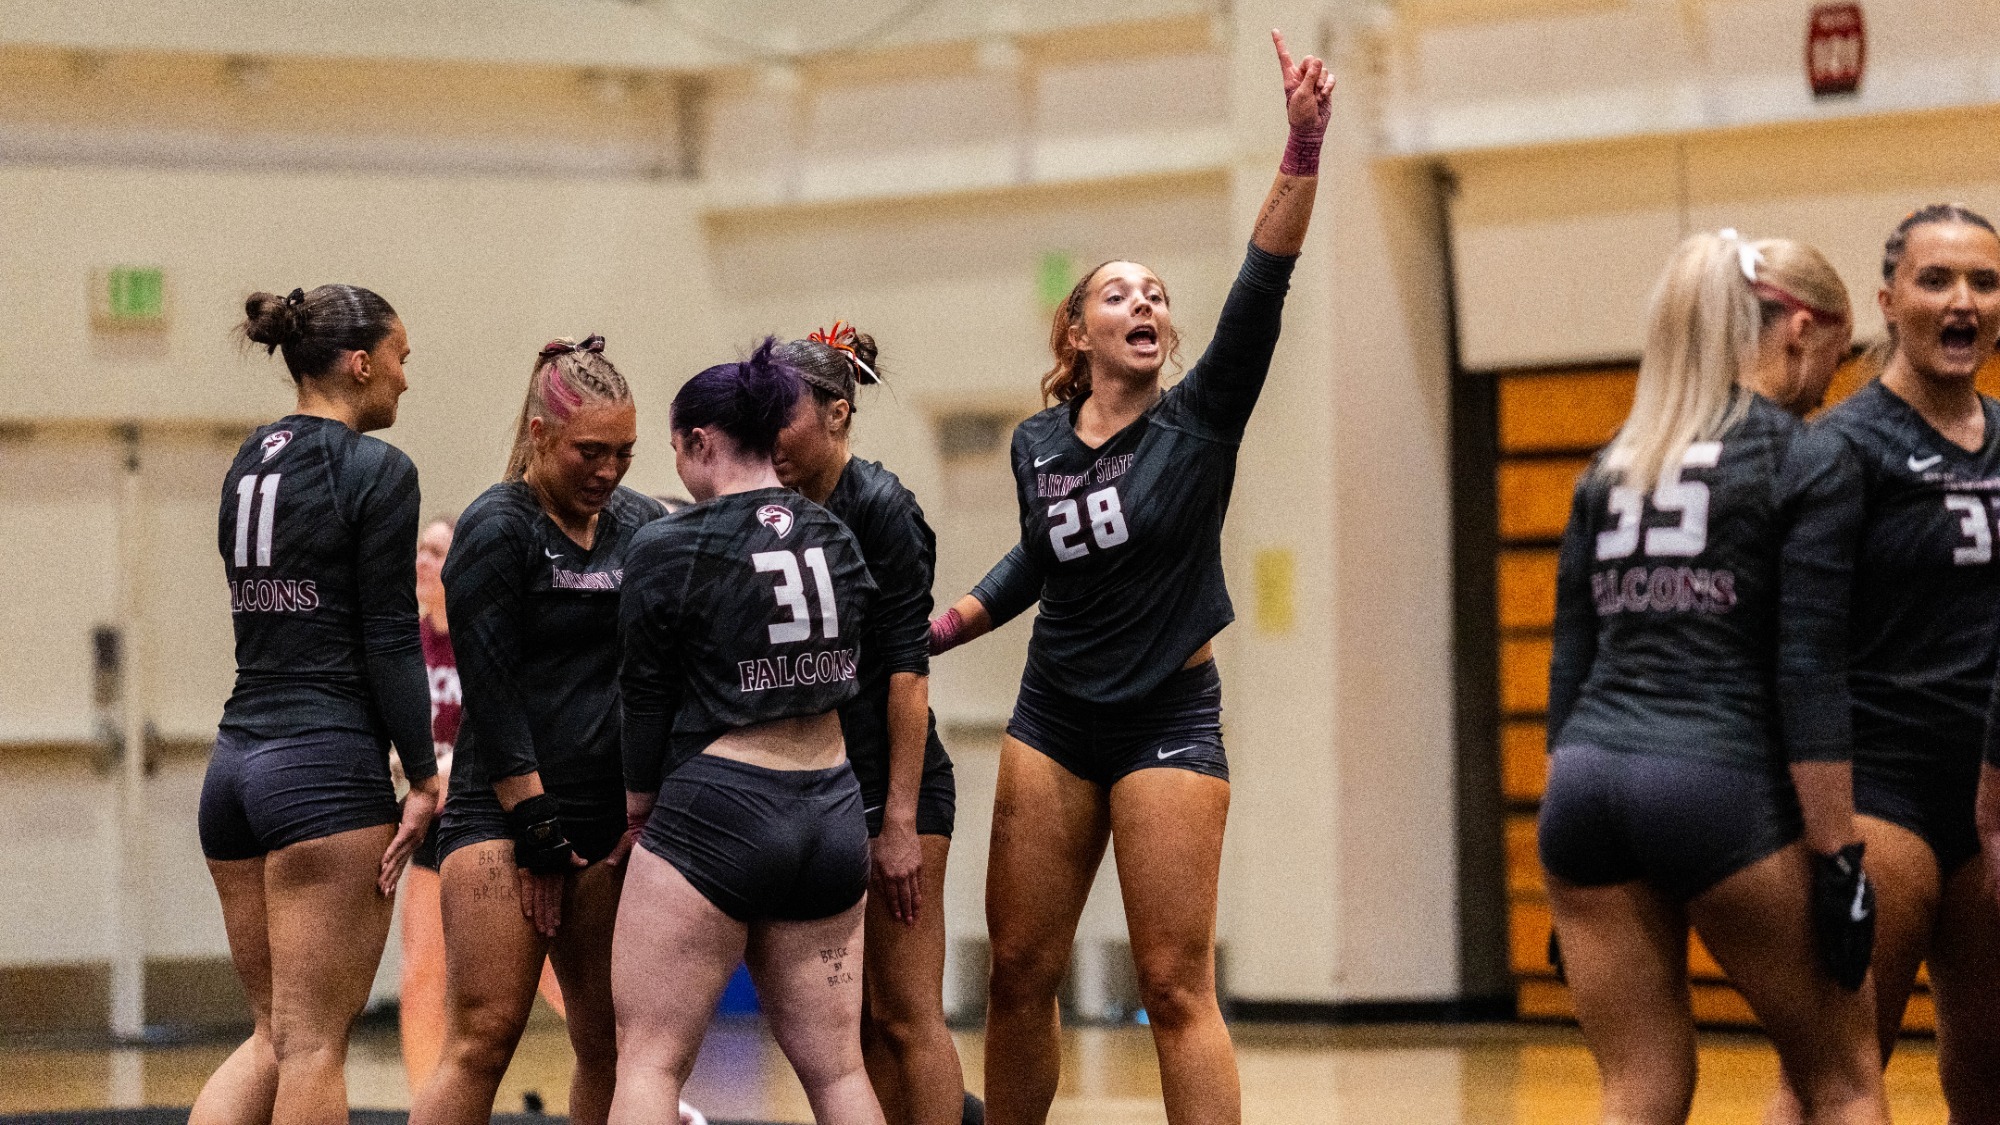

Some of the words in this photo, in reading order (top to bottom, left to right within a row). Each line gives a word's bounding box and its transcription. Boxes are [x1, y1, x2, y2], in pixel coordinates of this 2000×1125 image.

[235, 473, 281, 567] 11
[1047, 486, 1129, 562] 28
[1597, 441, 1723, 560] 35
[1945, 494, 2000, 565] 3
[231, 579, 319, 612] LCONS
[752, 547, 839, 644] 31
[1591, 566, 1737, 616] LCONS
[738, 648, 857, 692] FALCONS
[478, 849, 516, 866] BRIC
[473, 884, 516, 903] BRICK
[820, 947, 849, 963] BRICK
